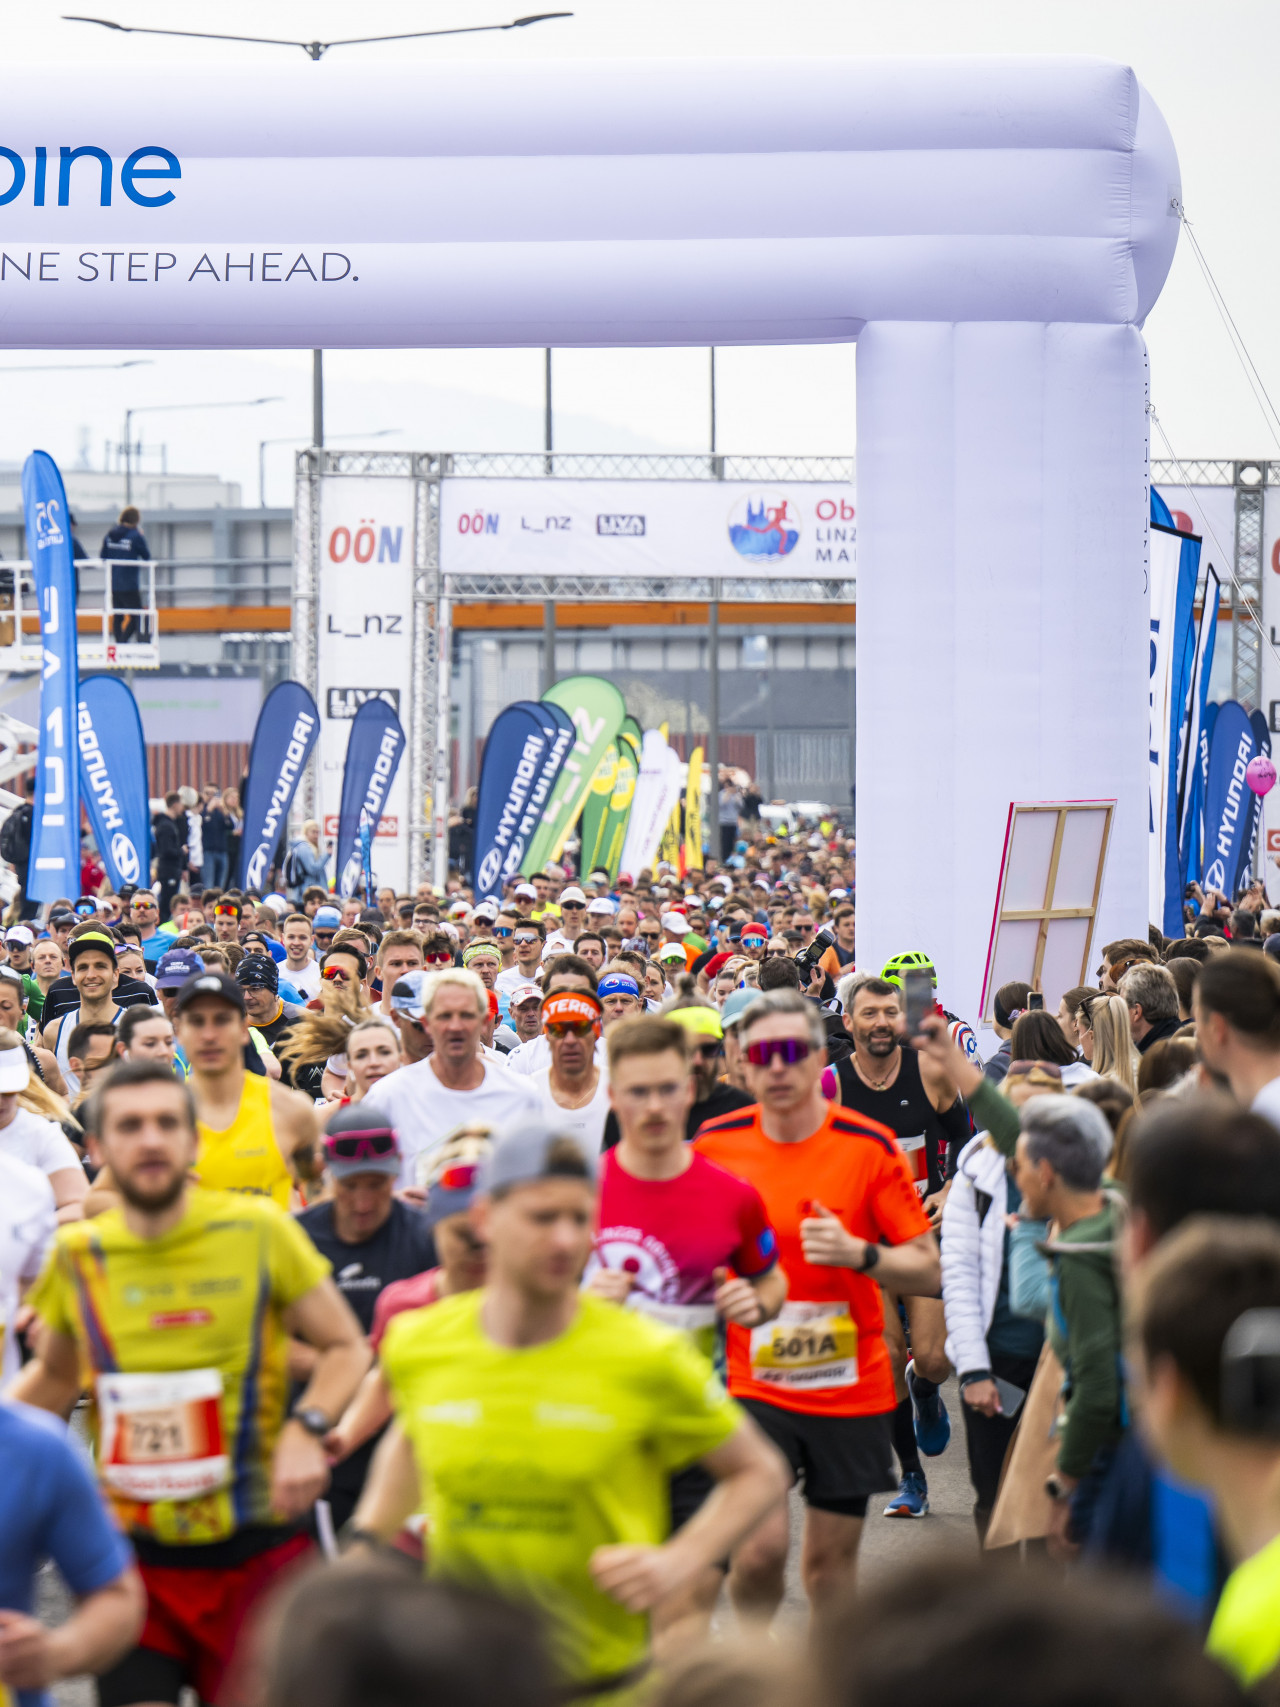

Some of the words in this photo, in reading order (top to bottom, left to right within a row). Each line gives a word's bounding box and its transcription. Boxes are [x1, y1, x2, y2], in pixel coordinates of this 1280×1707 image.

[77, 252, 177, 283] STEP
[188, 252, 360, 283] AHEAD.
[458, 508, 500, 535] OÖN
[328, 518, 404, 564] OÖN
[816, 549, 856, 562] MA
[327, 613, 403, 638] L_nz
[353, 726, 401, 847] UNDAI
[494, 734, 545, 847] HYUNDAI
[1216, 731, 1253, 858] HYUNDAI
[772, 1333, 838, 1358] 501A
